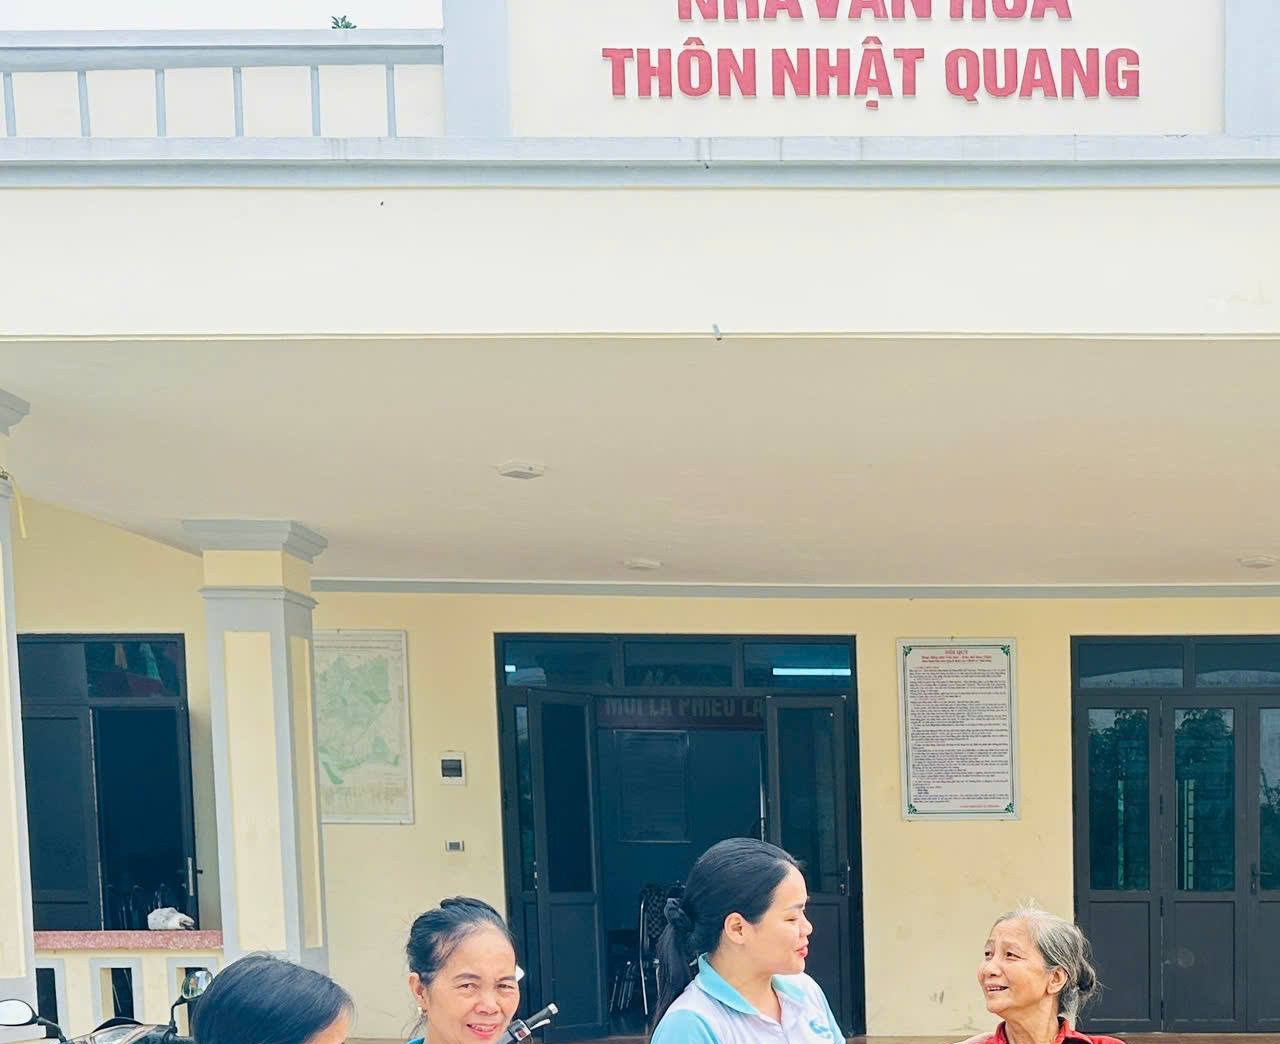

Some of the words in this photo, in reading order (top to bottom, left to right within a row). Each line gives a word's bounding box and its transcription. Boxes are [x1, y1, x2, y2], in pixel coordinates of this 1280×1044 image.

[601, 36, 757, 99] THÔN
[771, 35, 926, 111] NHẬT
[944, 47, 1141, 105] QUANG
